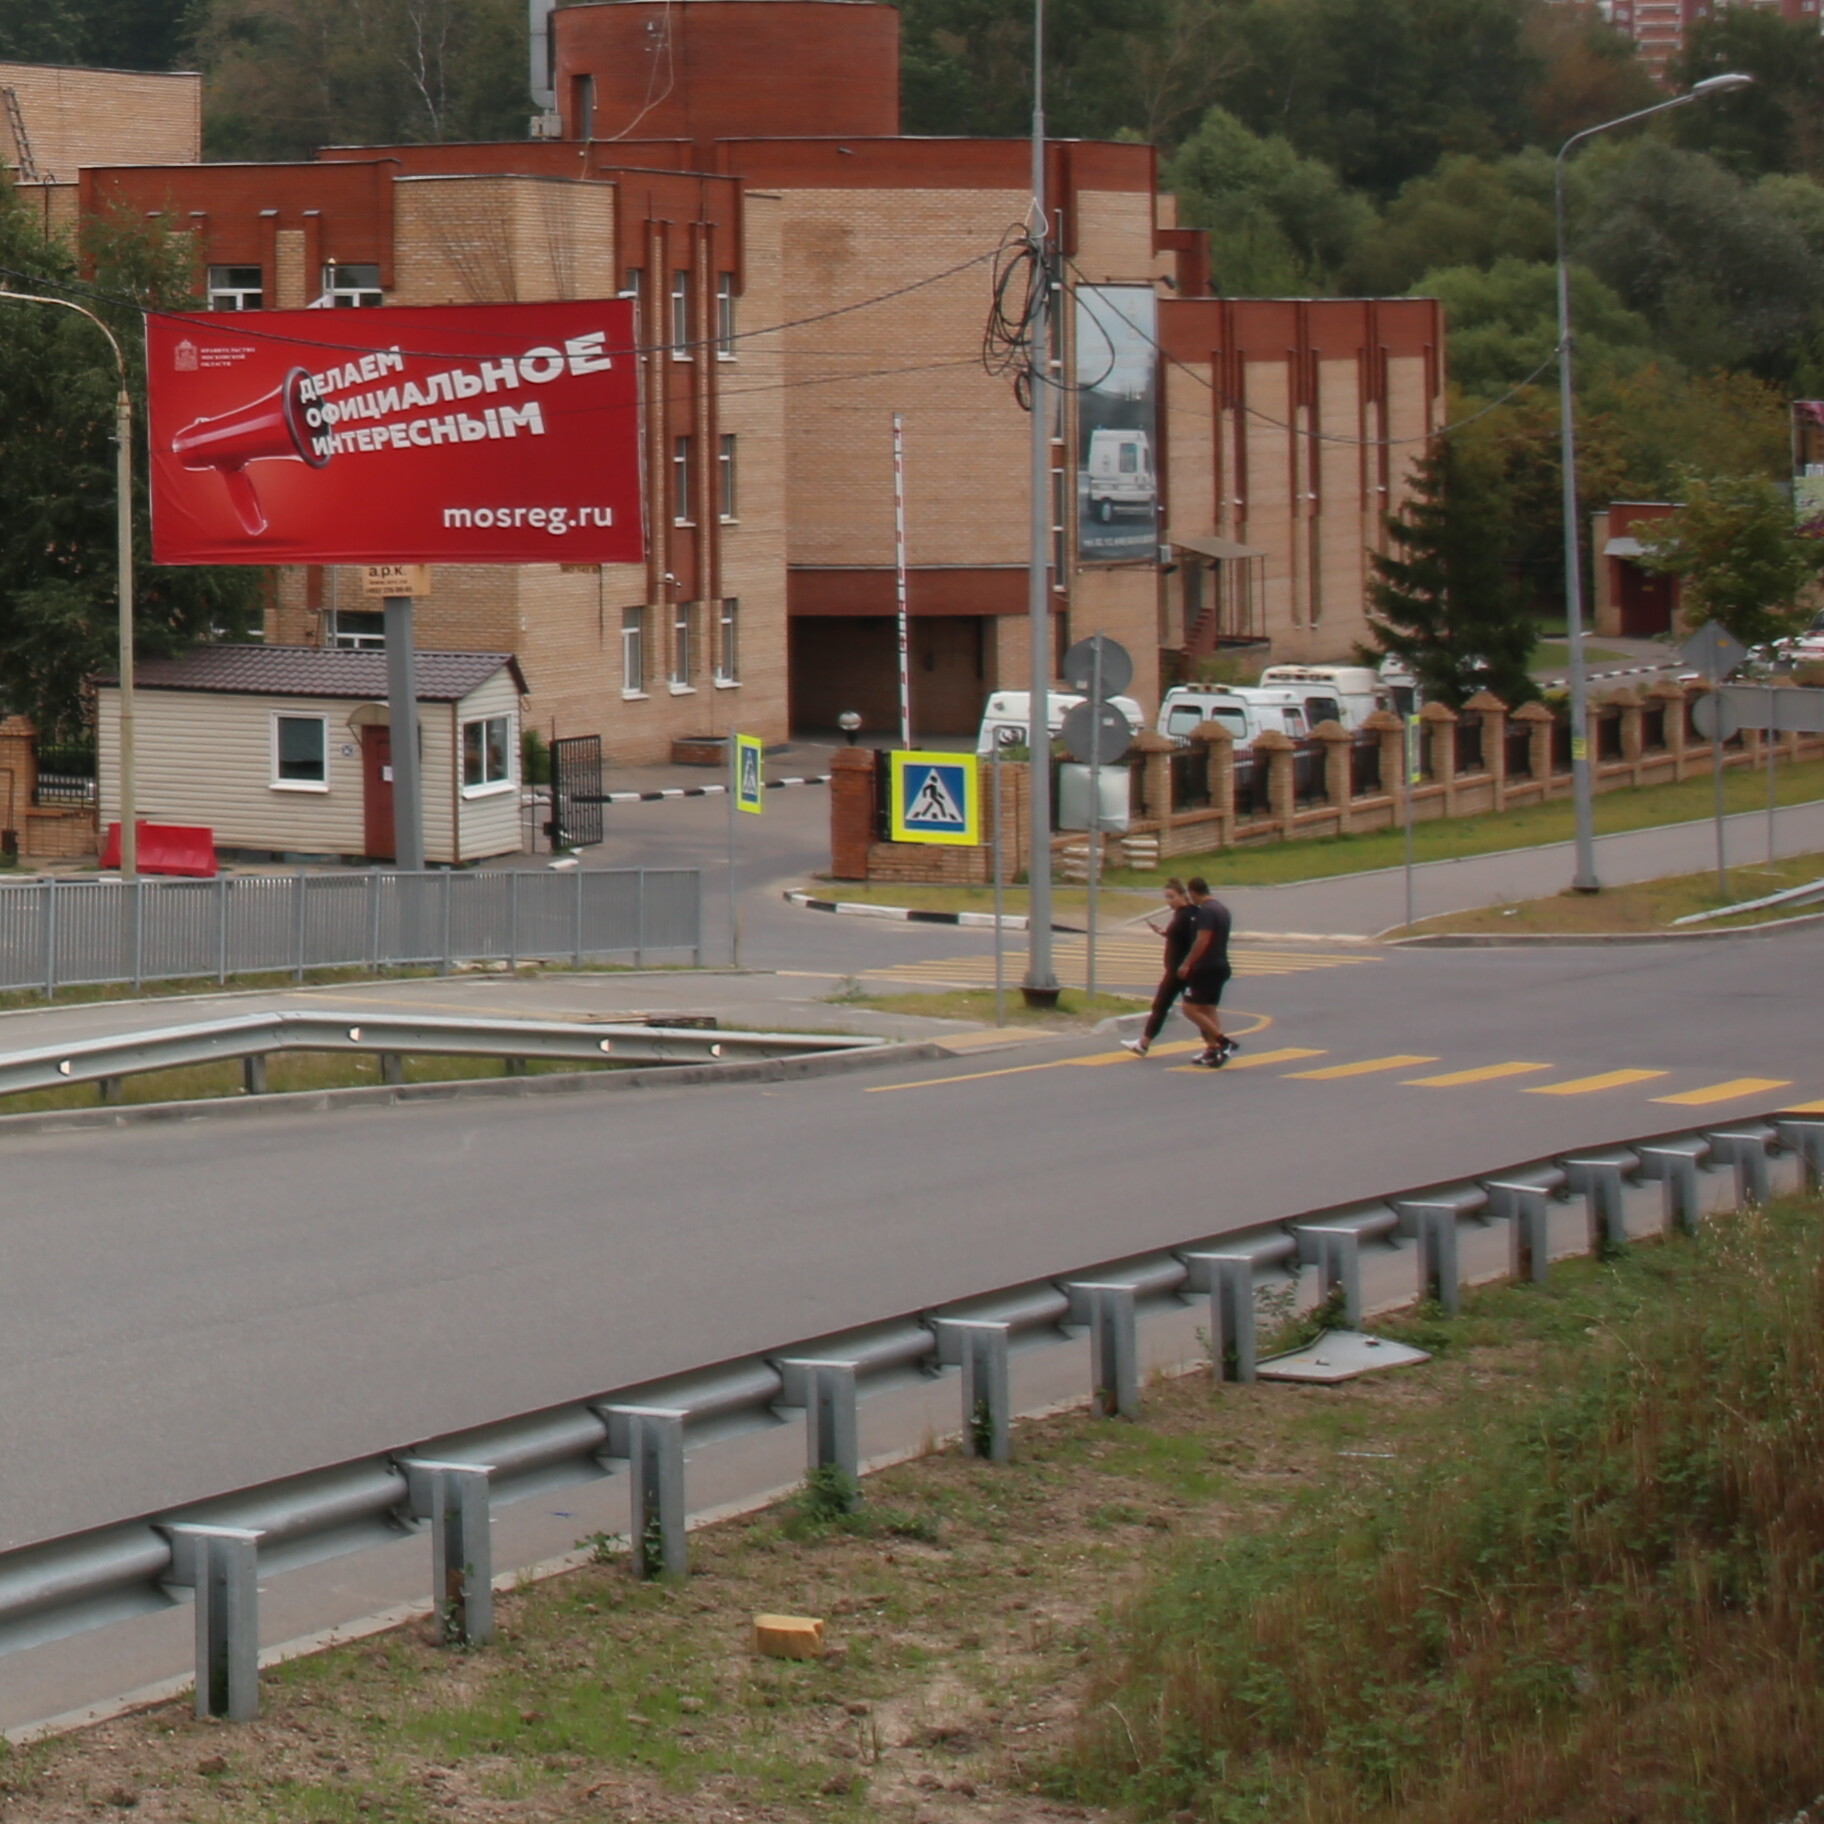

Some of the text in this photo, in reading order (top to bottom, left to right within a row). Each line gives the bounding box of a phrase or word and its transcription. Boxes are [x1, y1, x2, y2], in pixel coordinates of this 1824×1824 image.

[299, 345, 404, 404] ДЕЛАЕМ
[305, 331, 612, 428] ОФИЦИАЛЬНОЕ
[311, 401, 545, 456] ИНТЕРЕСНЫМ
[443, 507, 613, 535] mosreg.ru
